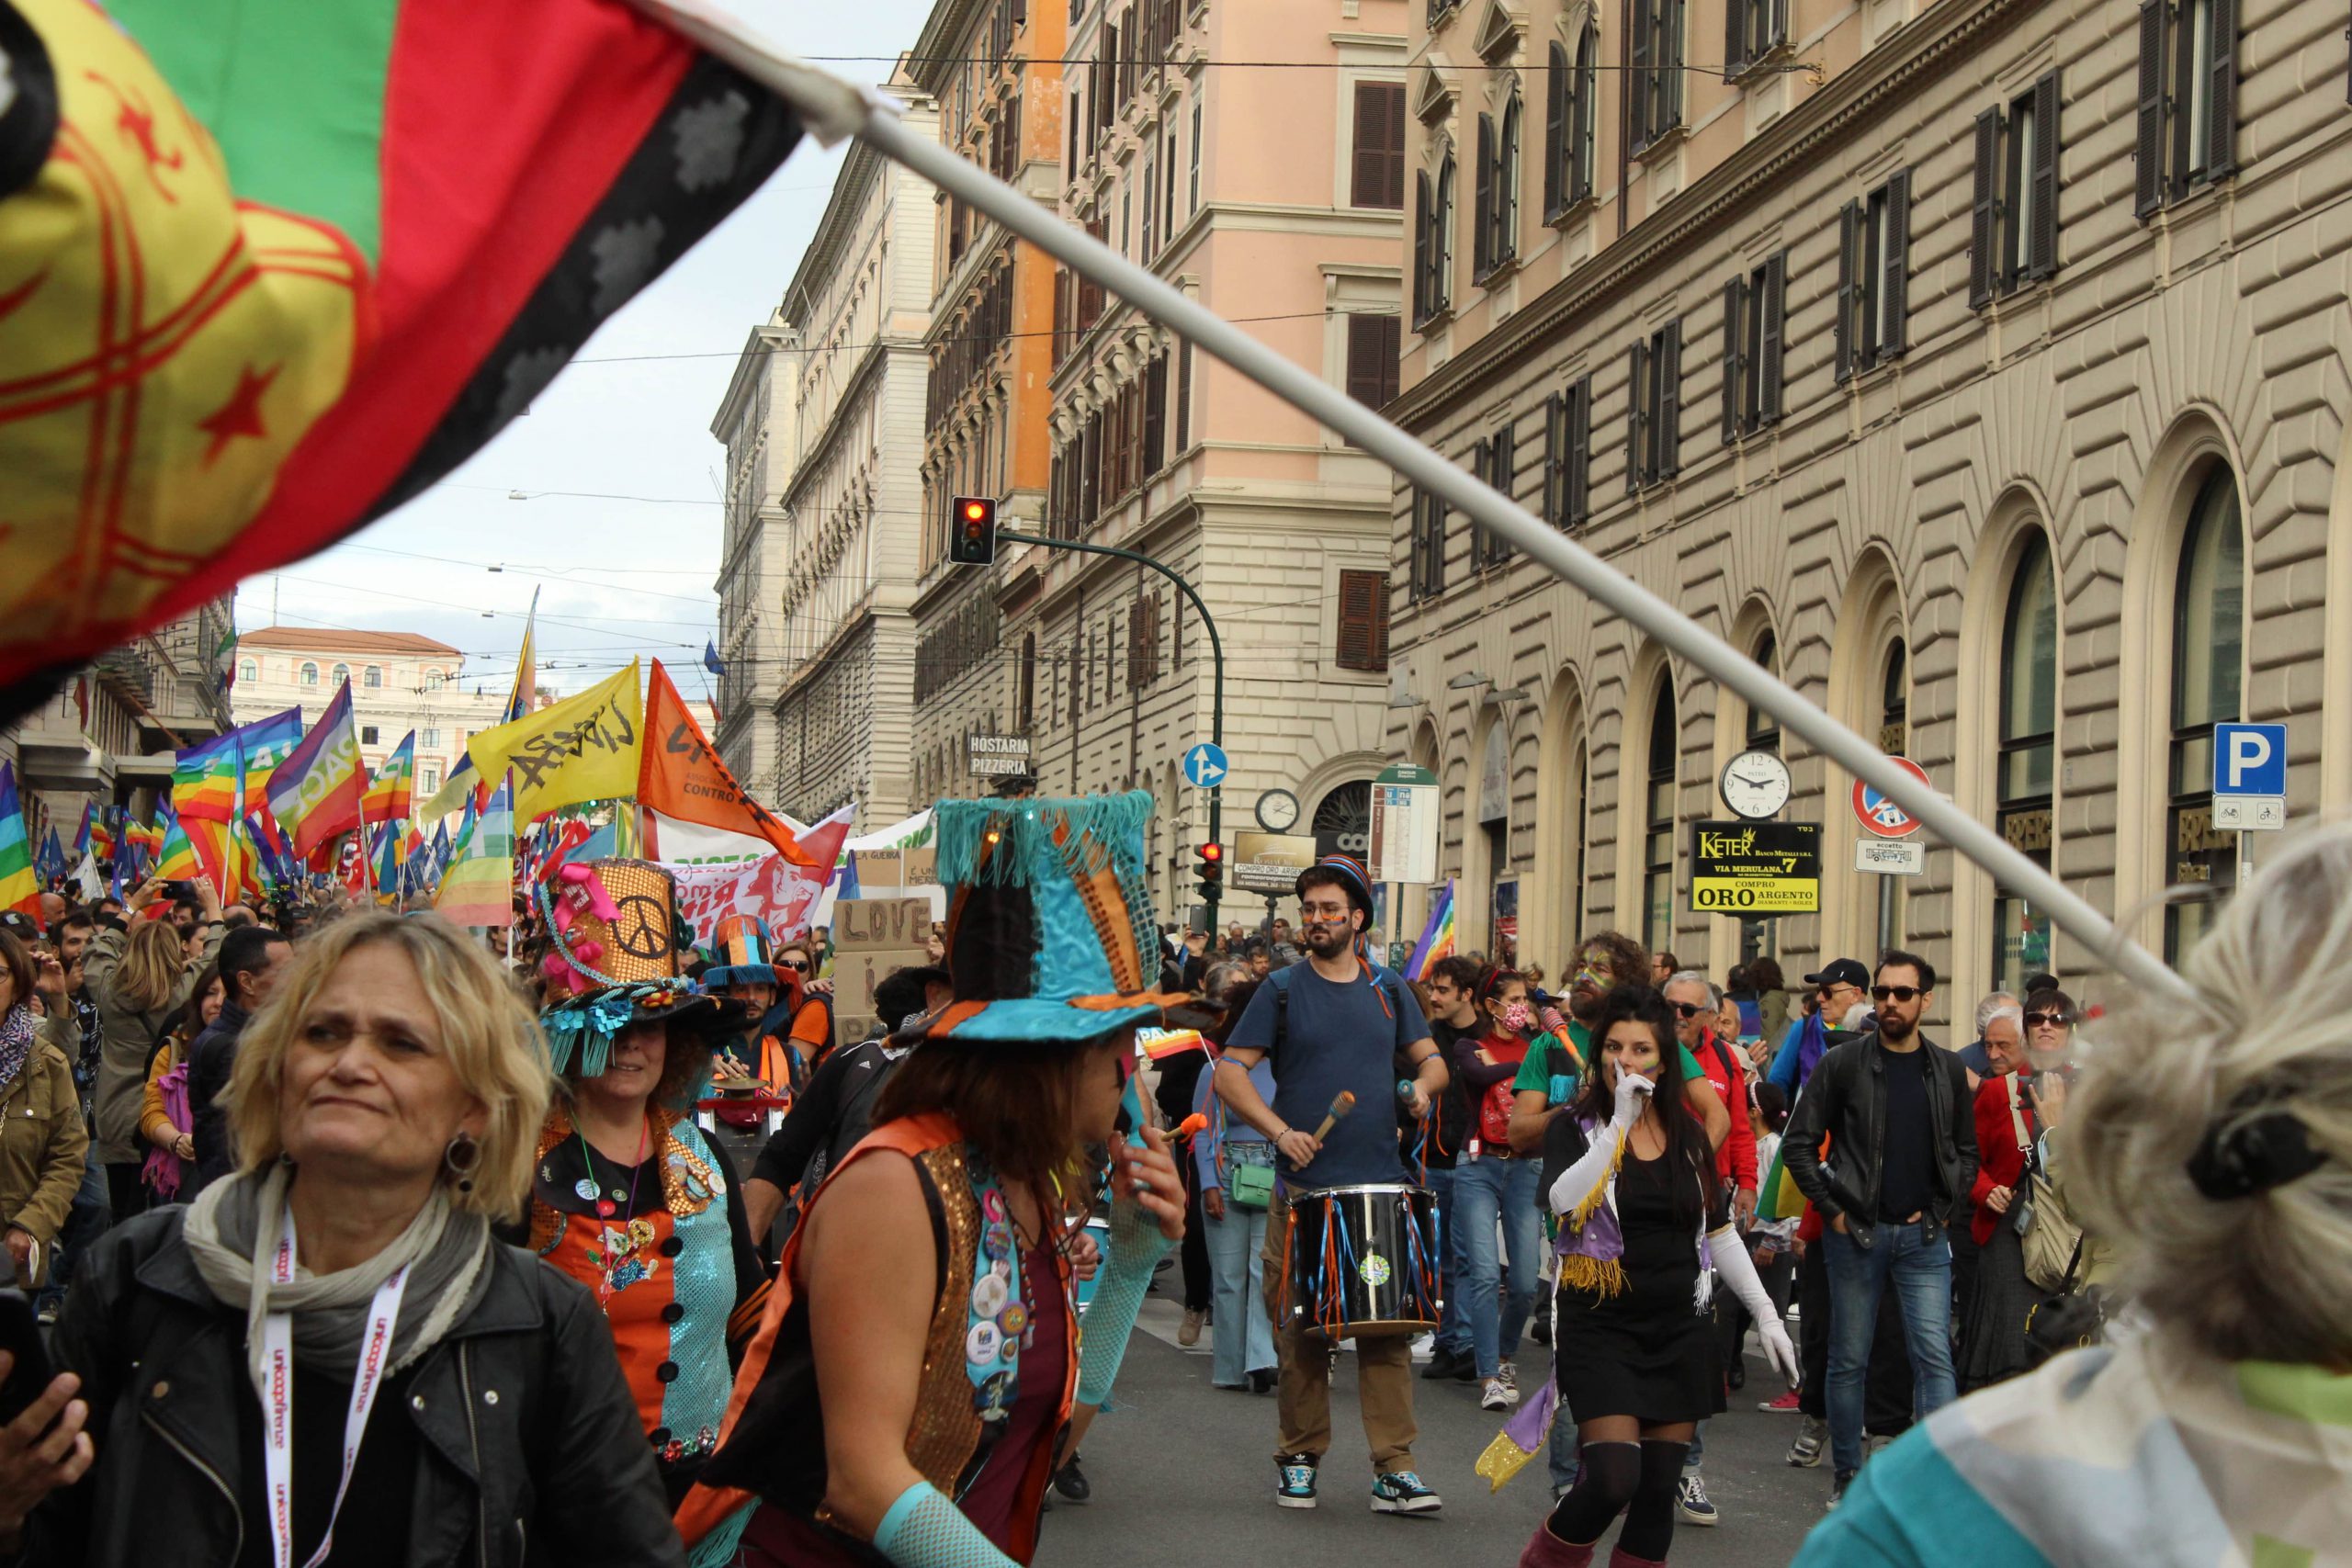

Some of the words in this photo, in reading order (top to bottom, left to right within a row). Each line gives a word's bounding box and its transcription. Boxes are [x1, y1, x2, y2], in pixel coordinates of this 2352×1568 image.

[970, 737, 1029, 753] HOSTARIA
[972, 758, 1027, 774] PIZZERIA
[1751, 755, 1763, 766] 12
[2229, 731, 2271, 787] P
[1727, 779, 1735, 789] 9
[1779, 779, 1786, 790] 3
[684, 782, 735, 804] CONTRO
[1752, 804, 1759, 814] 6
[1698, 831, 1751, 858] KETER
[855, 851, 868, 860] LA
[870, 851, 901, 861] GUERRA
[1238, 864, 1265, 873] COMPRO
[1732, 865, 1783, 874] MERULANA,
[1782, 858, 1797, 873] 7
[1698, 888, 1755, 907] ORO
[1758, 891, 1814, 899] ARGENTO
[842, 897, 930, 944] LOVE
